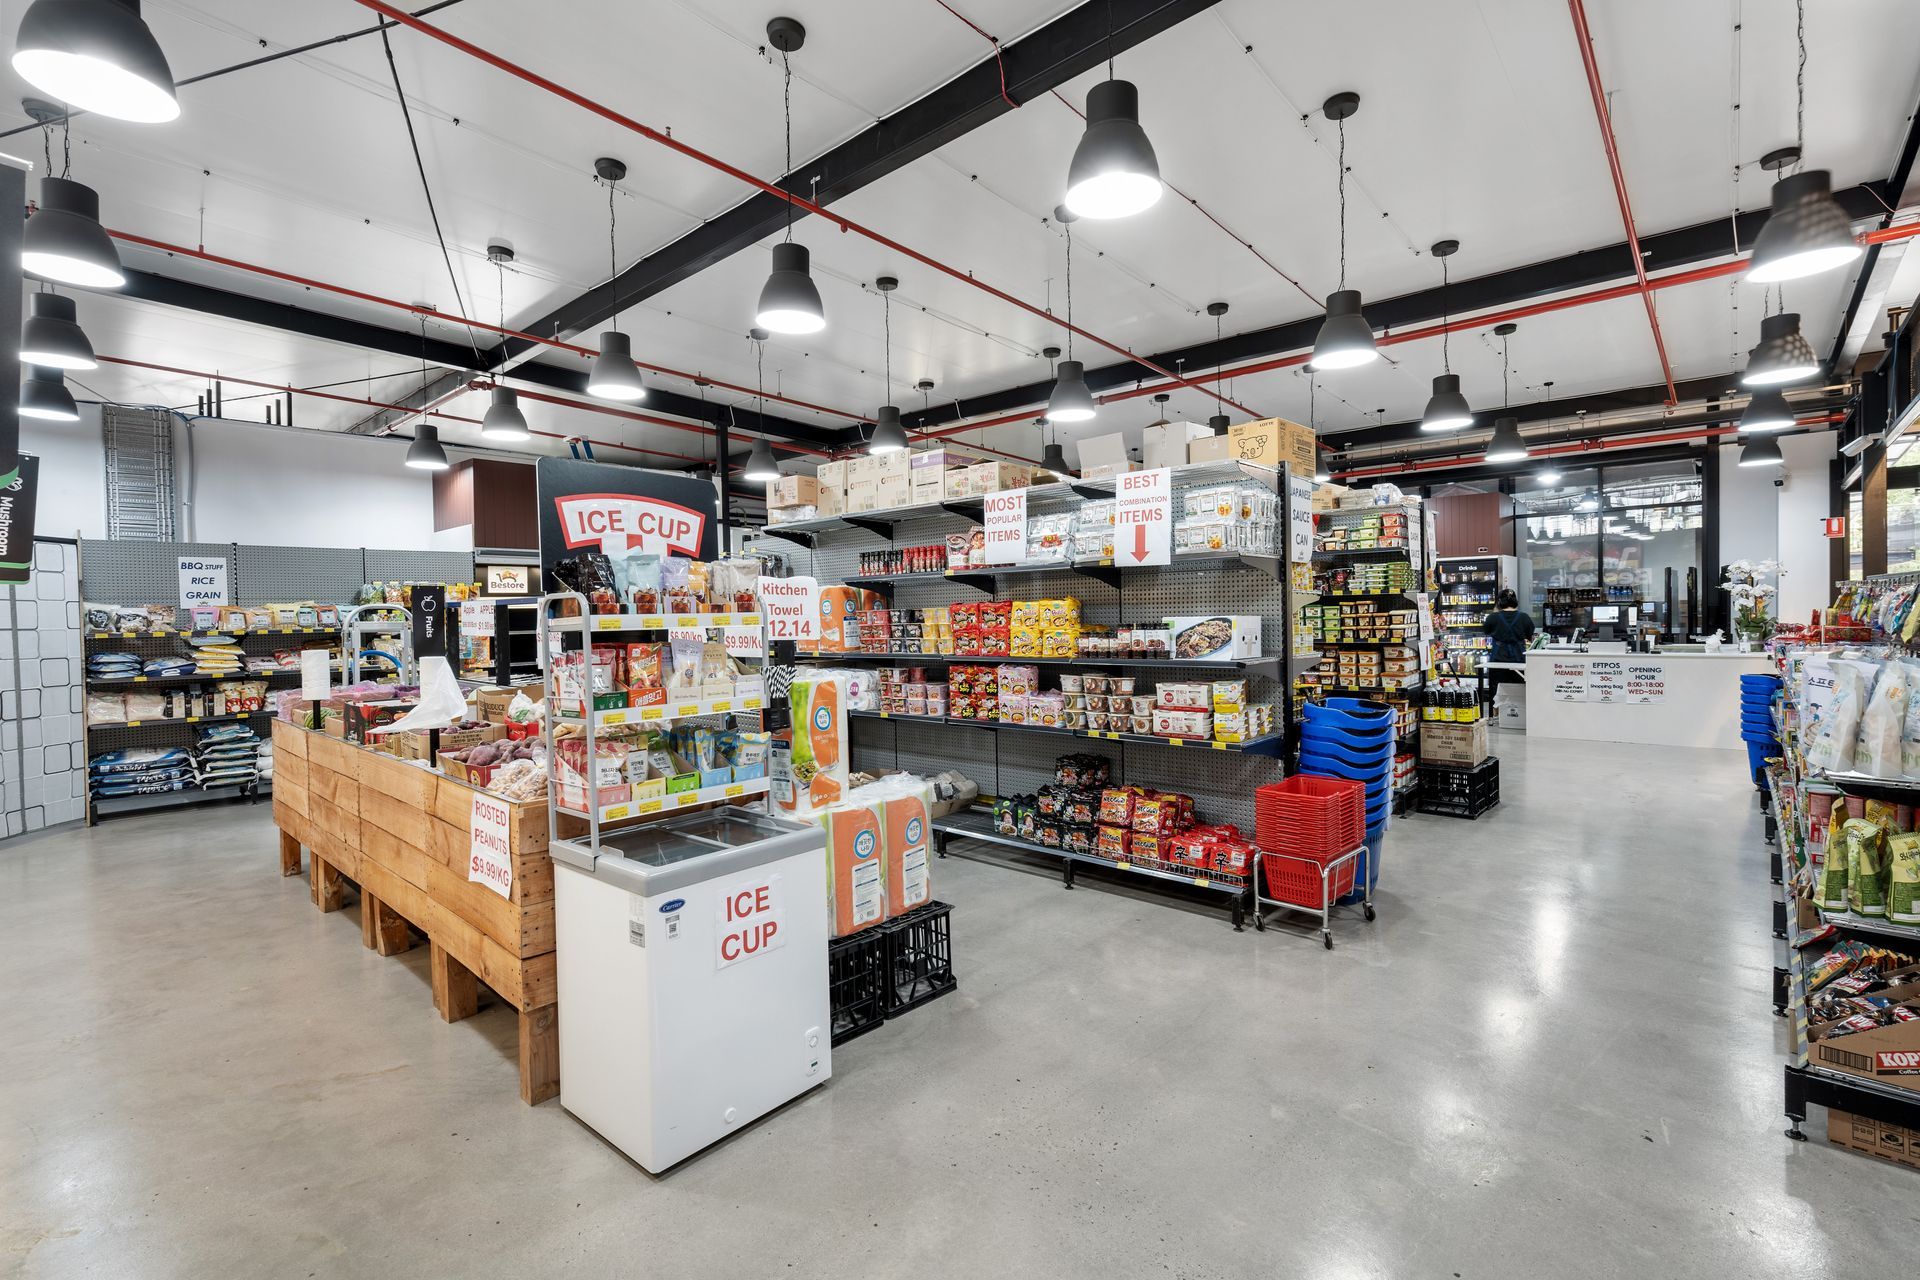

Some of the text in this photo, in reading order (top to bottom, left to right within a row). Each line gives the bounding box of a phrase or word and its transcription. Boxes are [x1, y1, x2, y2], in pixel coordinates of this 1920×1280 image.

[1123, 474, 1159, 490] BEST
[985, 495, 1024, 513] MOST
[1119, 495, 1168, 507] COMBINATION
[986, 514, 1022, 525] POPULAR
[1119, 508, 1163, 523] ITEMS
[1292, 509, 1310, 523] SAUCE
[0, 496, 14, 556] Mushroom
[578, 510, 691, 541] ICE CUP
[987, 529, 1021, 543] ITEMS
[1295, 533, 1309, 546] CAN
[181, 562, 203, 570] BBQ
[191, 577, 215, 585] RICE
[490, 581, 525, 589] Bestore
[186, 591, 221, 600] GRAIN
[762, 583, 808, 596] Kitchen
[480, 605, 495, 615] APPLE
[768, 603, 803, 616] Towel
[425, 615, 433, 638] Fruits
[769, 619, 811, 637] 12.14
[475, 800, 507, 827] ROSTED
[474, 828, 507, 855] PEANUTS
[1173, 845, 1189, 866] 辛
[1213, 851, 1231, 873] 辛
[472, 855, 509, 887] $9.99/KG
[661, 900, 684, 913] Carrier
[726, 885, 770, 922] ICE
[721, 921, 778, 961] CUP
[1878, 1052, 1920, 1067] KOP
